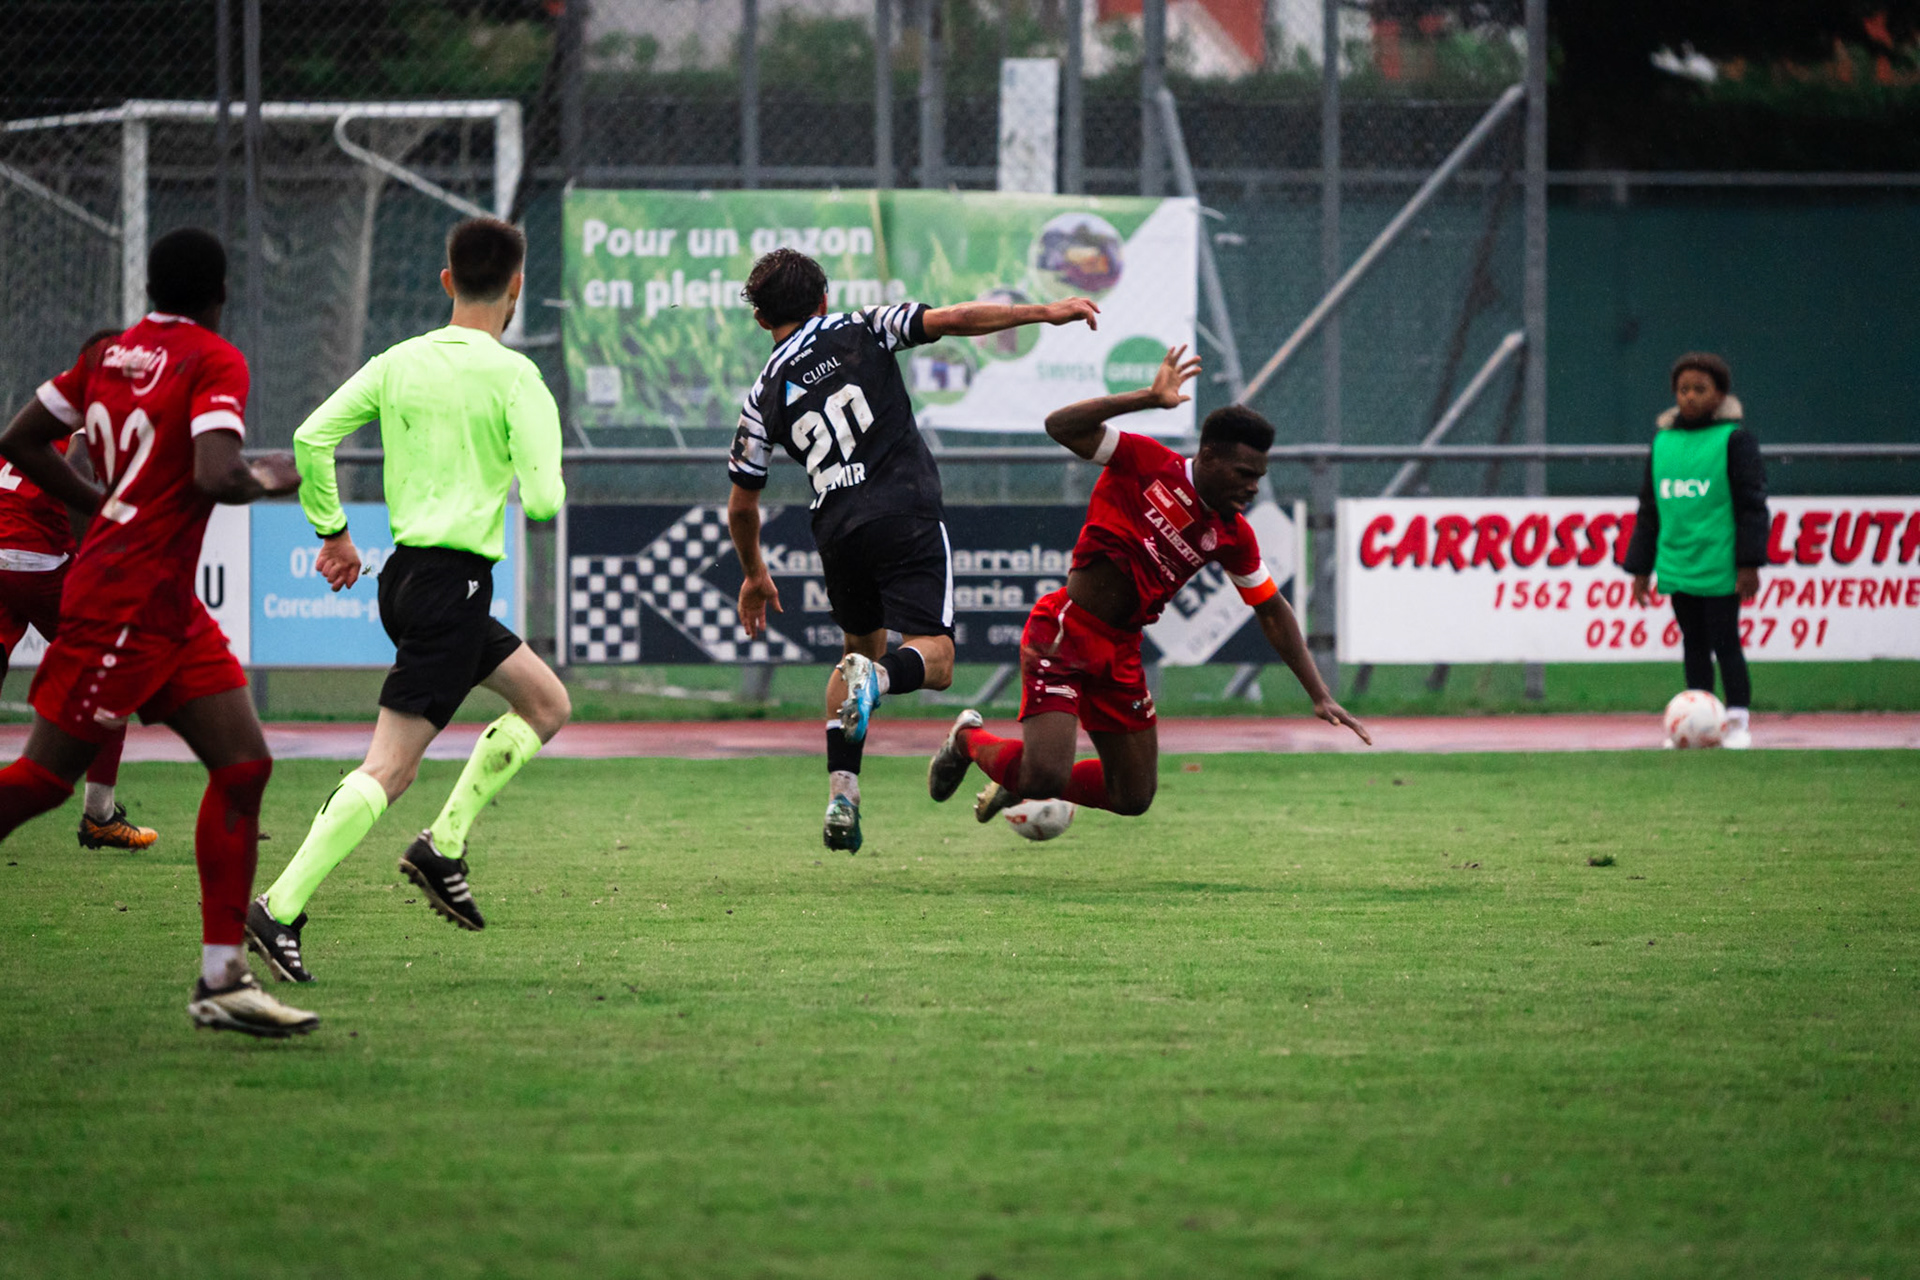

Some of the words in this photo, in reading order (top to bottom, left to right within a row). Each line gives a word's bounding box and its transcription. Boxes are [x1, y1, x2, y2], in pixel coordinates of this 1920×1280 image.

[582, 218, 677, 256] Pour
[687, 228, 739, 256] un
[751, 226, 874, 256] gazon
[584, 279, 632, 308] en
[645, 269, 749, 319] plein
[828, 279, 906, 307] rme
[802, 356, 842, 384] CLIPAL
[791, 384, 875, 498] 20
[85, 401, 156, 525] 22
[1674, 478, 1710, 498] BCV
[953, 544, 1074, 572] arrela
[1360, 512, 1638, 573] CARROSS
[1494, 580, 1571, 609] 1562
[1586, 618, 1648, 649] 026
[1791, 618, 1829, 649] 91
